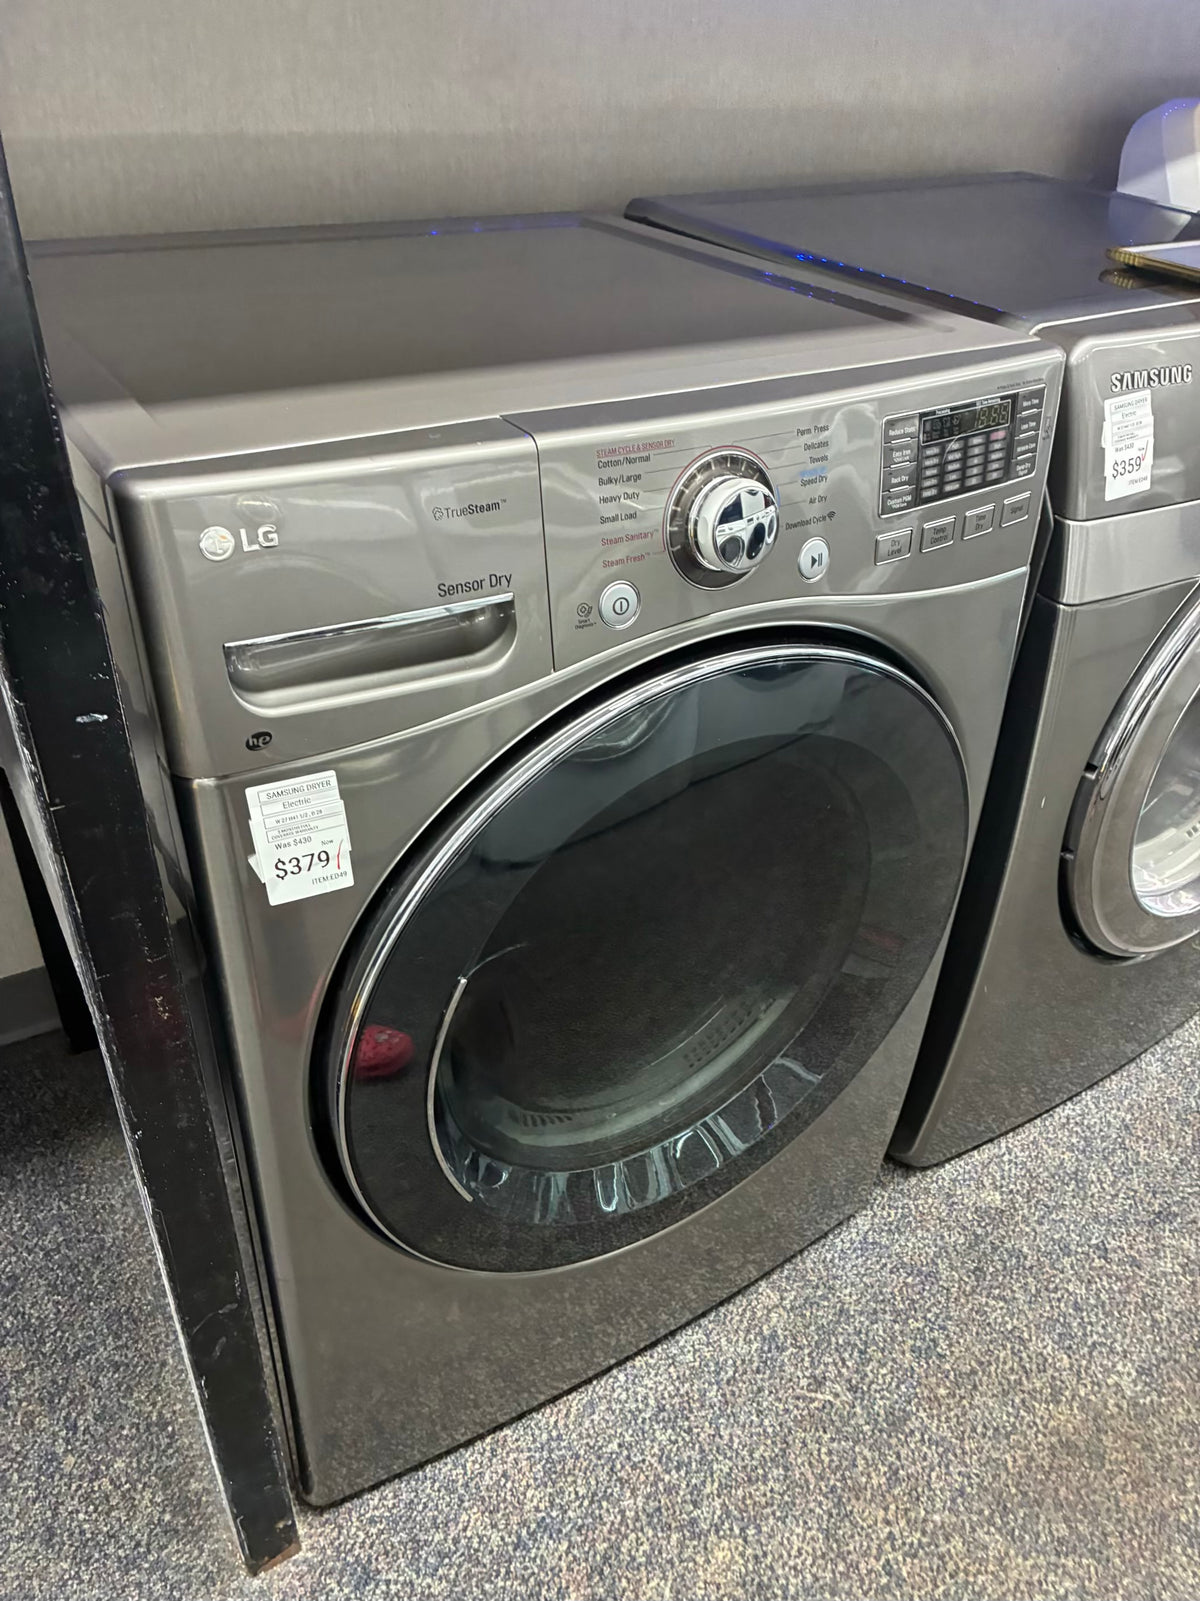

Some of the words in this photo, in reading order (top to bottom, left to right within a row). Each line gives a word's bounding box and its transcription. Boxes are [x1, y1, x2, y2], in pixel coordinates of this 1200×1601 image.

[1110, 364, 1192, 393] SAMSUNG
[796, 428, 812, 437] Perm
[814, 424, 830, 433] Press
[803, 440, 829, 451] Delicates
[596, 448, 617, 459] STEAM
[809, 454, 829, 464] Towels
[597, 453, 651, 470] Cotton/Normal
[1112, 455, 1141, 480] $359
[598, 474, 642, 487] Bulky/Large
[800, 478, 817, 487] Speed
[818, 475, 828, 485] Dry
[599, 494, 622, 505] Heavy
[623, 491, 640, 501] Duty
[817, 494, 828, 503] Dry
[600, 513, 620, 525] Small
[620, 511, 637, 521] Load
[785, 518, 812, 531] Download
[813, 514, 828, 526] Cycle
[239, 524, 279, 552] LG
[601, 536, 624, 547] Steam
[891, 539, 900, 548] Dry
[887, 548, 902, 557] Level
[602, 557, 625, 568] Steam
[437, 579, 485, 598] Sensor
[489, 573, 512, 588] Dry
[266, 785, 305, 800] SAMSUNG
[306, 779, 331, 792] DRYER
[282, 797, 311, 809] Electric
[275, 842, 291, 850] Was
[293, 836, 312, 847] $430
[274, 850, 330, 880] $379
